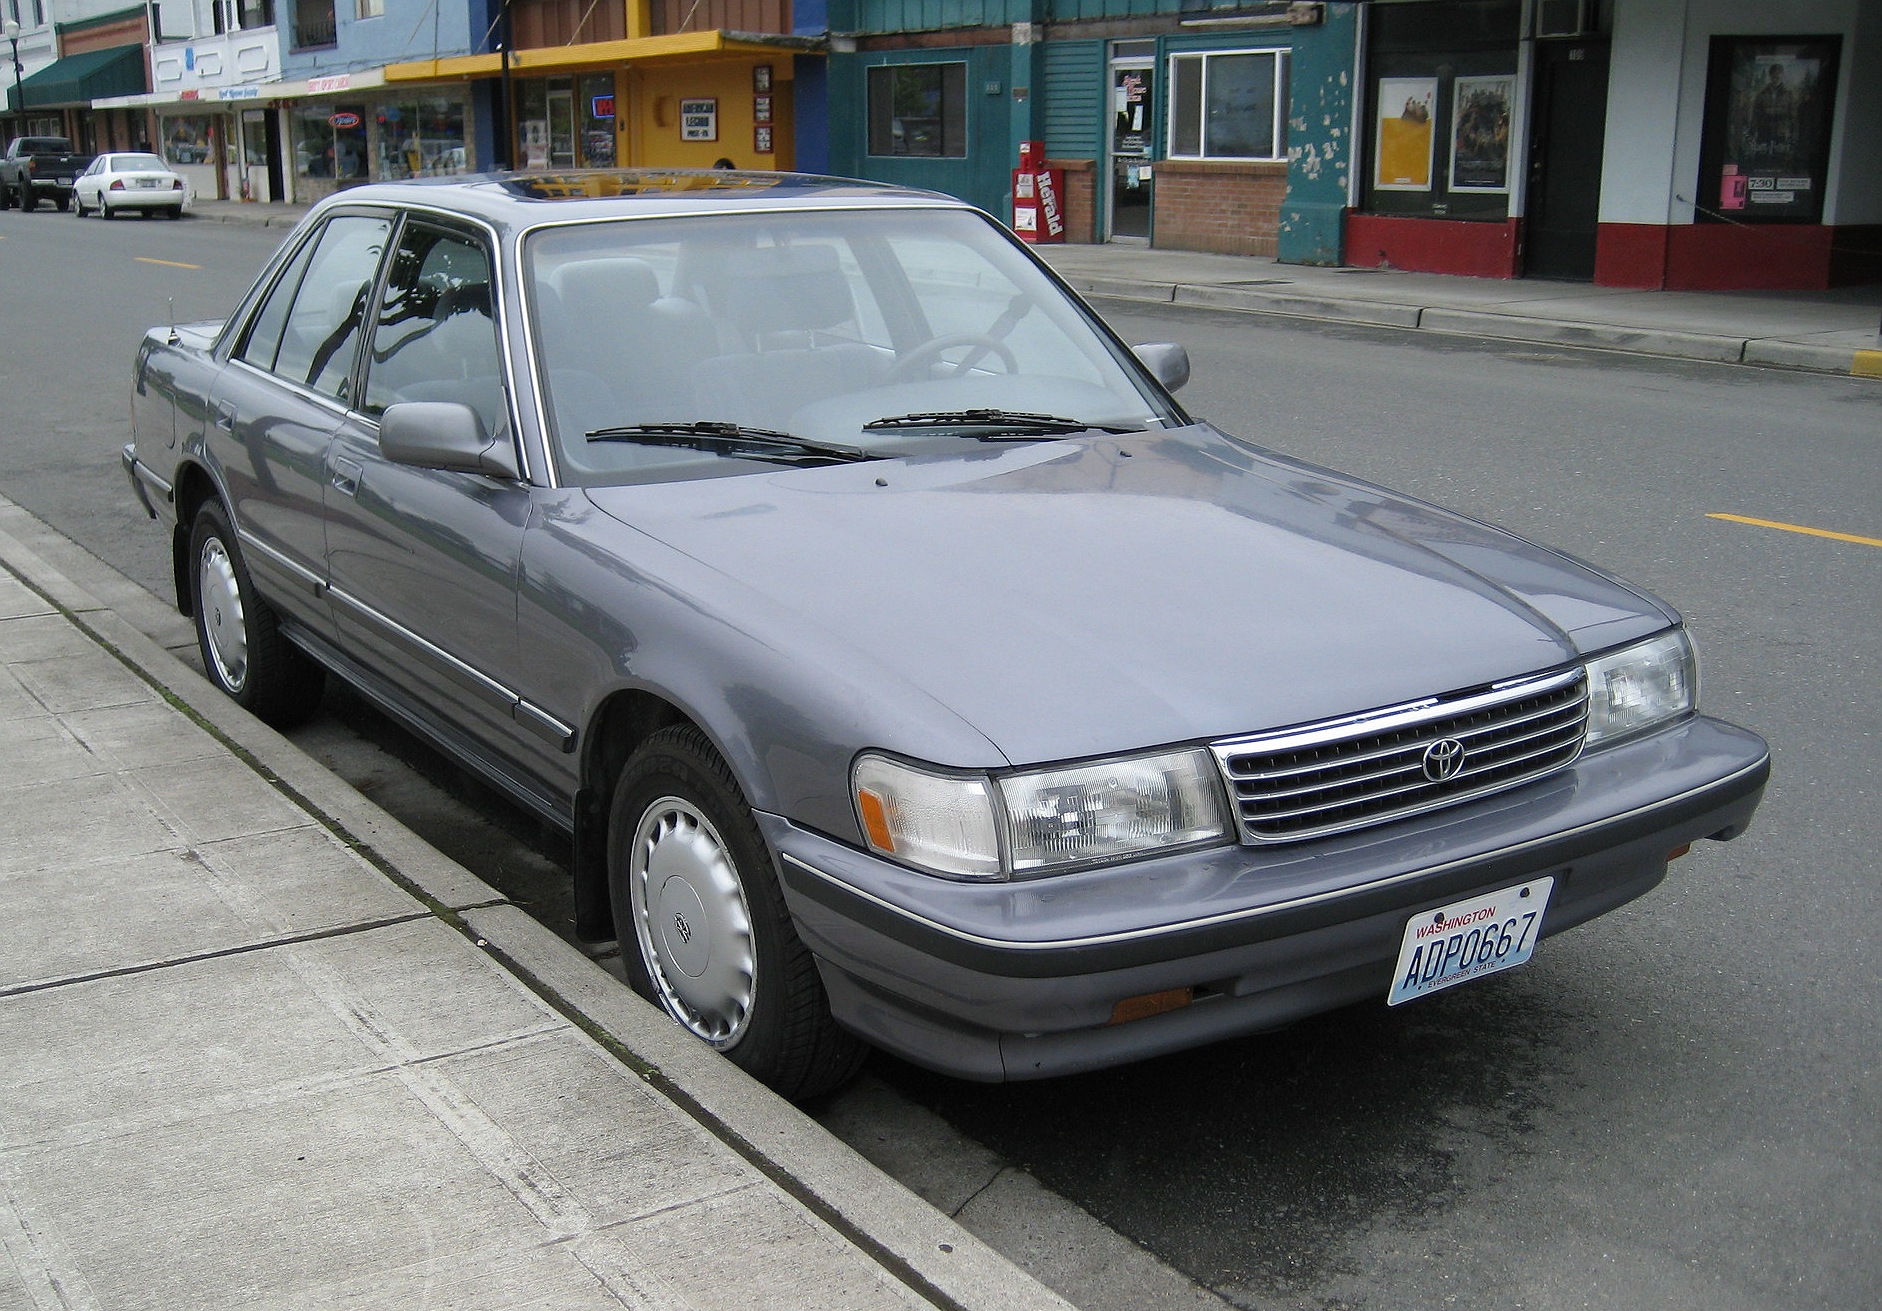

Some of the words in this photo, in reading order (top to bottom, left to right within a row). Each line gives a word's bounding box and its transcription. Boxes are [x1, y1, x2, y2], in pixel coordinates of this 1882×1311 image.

[1036, 171, 1064, 236] Herald
[1416, 906, 1497, 939] WASHINGTON
[1402, 911, 1538, 990] ADP0667
[1427, 969, 1470, 989] EVERGREEN
[1473, 960, 1497, 974] STATE
